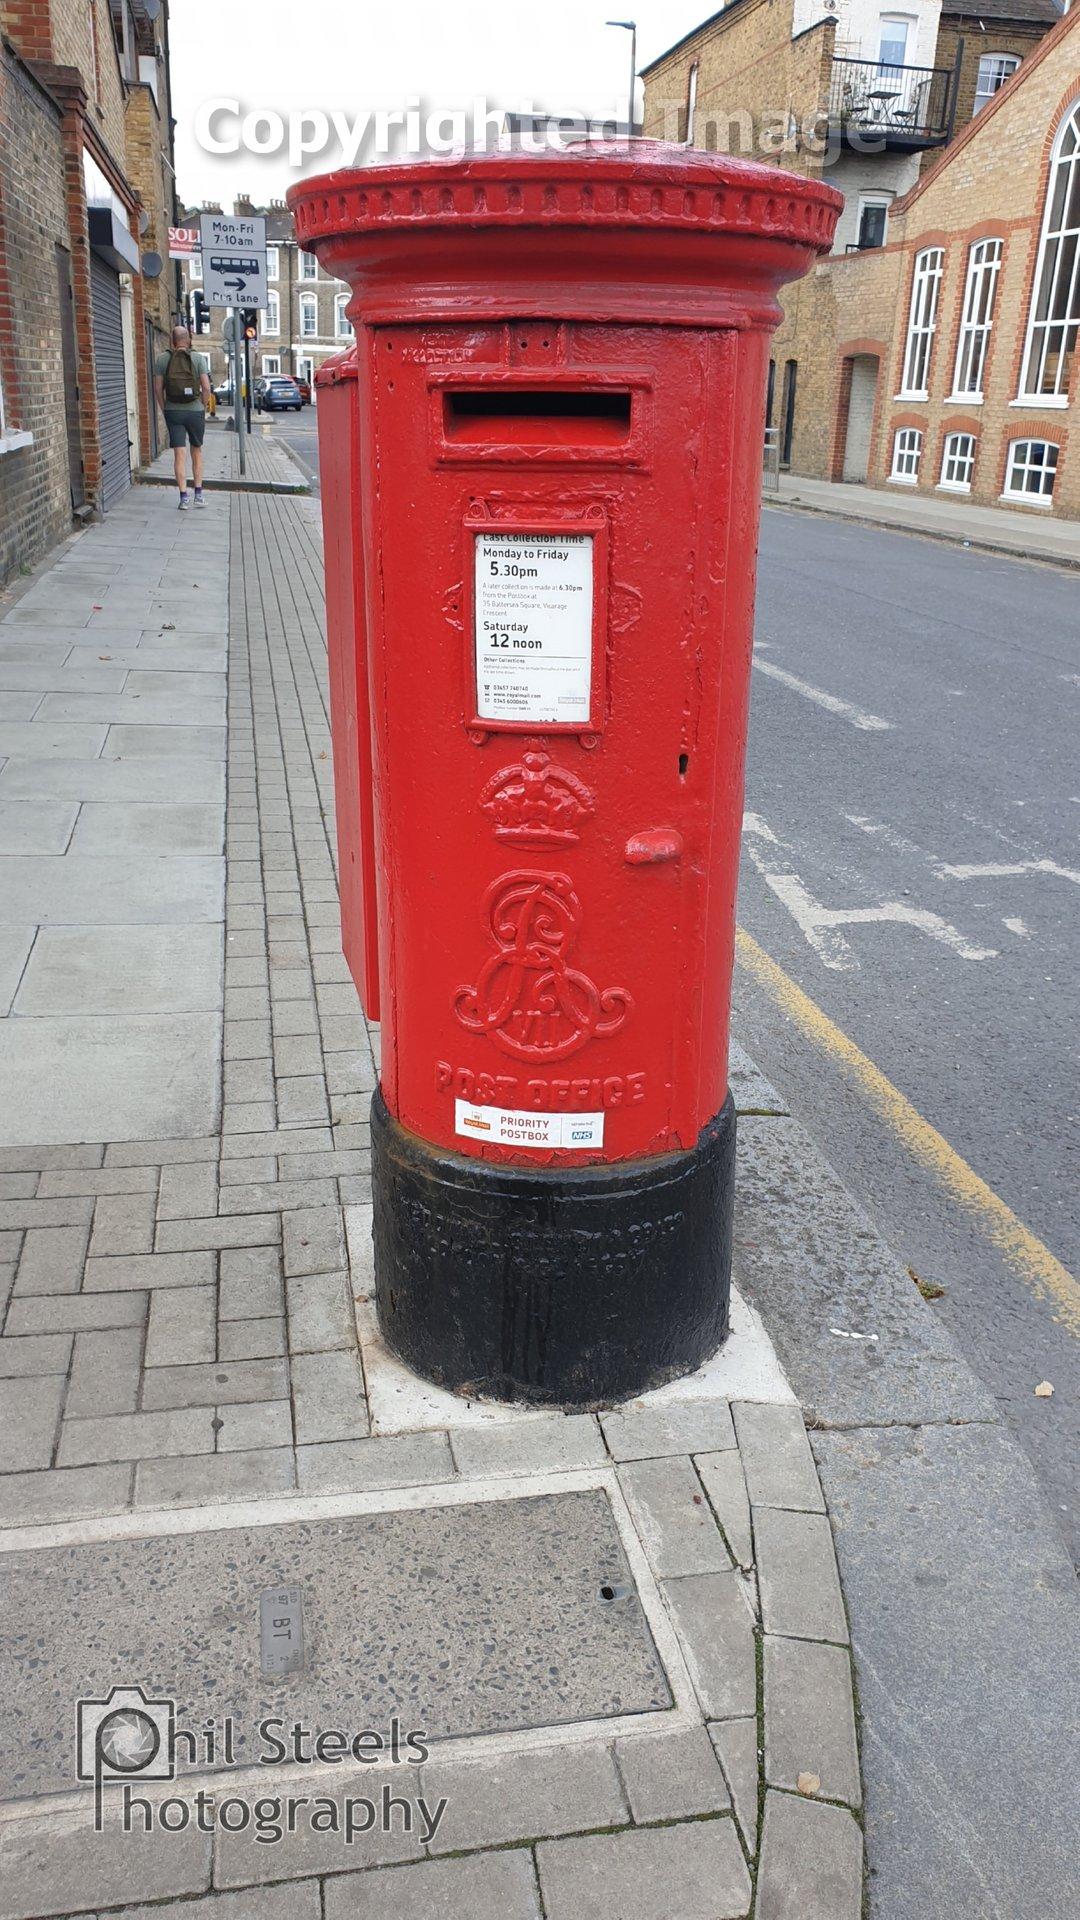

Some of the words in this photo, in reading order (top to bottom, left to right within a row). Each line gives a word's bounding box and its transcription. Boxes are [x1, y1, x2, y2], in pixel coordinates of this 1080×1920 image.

[214, 234, 253, 246] 7-10am
[236, 292, 259, 303] lane
[507, 534, 556, 544] Collection
[483, 548, 521, 559] Monday
[524, 550, 534, 559] to
[537, 549, 569, 562] Friday
[490, 561, 538, 579] 5.30pm
[519, 601, 541, 610] Square,
[543, 602, 568, 611] Vicarage
[483, 621, 529, 634] Saturday
[490, 633, 509, 648] 12
[513, 639, 542, 649] noon
[435, 1060, 518, 1102] POST
[527, 1071, 647, 1108] OFFICE
[500, 1116, 550, 1129] PRIORITY
[500, 1128, 550, 1141] POSTBOX
[572, 1131, 593, 1140] NHS
[273, 1617, 292, 1640] BT
